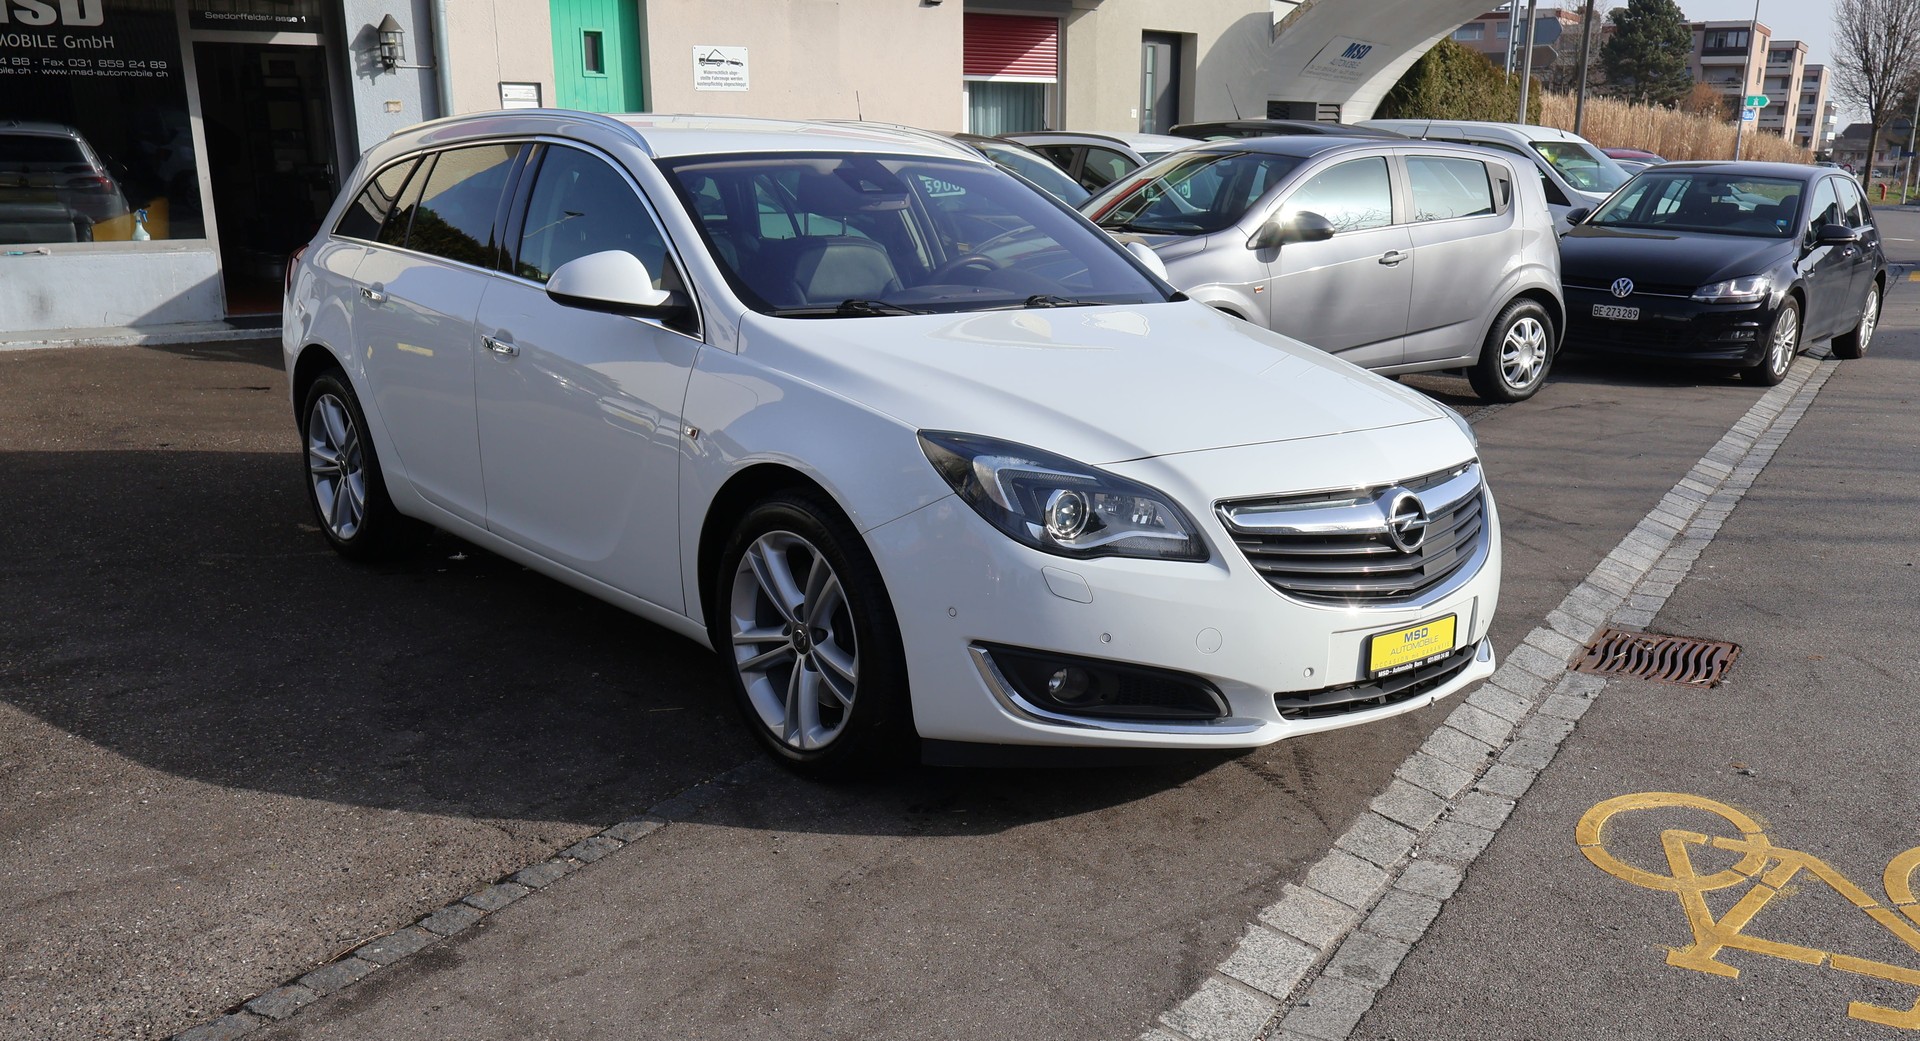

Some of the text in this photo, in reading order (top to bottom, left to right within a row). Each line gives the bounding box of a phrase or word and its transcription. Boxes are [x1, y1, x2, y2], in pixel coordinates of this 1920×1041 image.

[300, 15, 306, 23] 1
[63, 35, 115, 49] GmbH
[1341, 42, 1373, 60] MSD
[12, 57, 30, 66] 88
[42, 57, 65, 67] Fax
[68, 58, 92, 67] 031
[98, 59, 125, 68] 859
[128, 60, 146, 69] 24
[149, 60, 167, 69] 89
[1404, 627, 1429, 643] MSD
[1390, 634, 1439, 656] AUTOMOBILE
